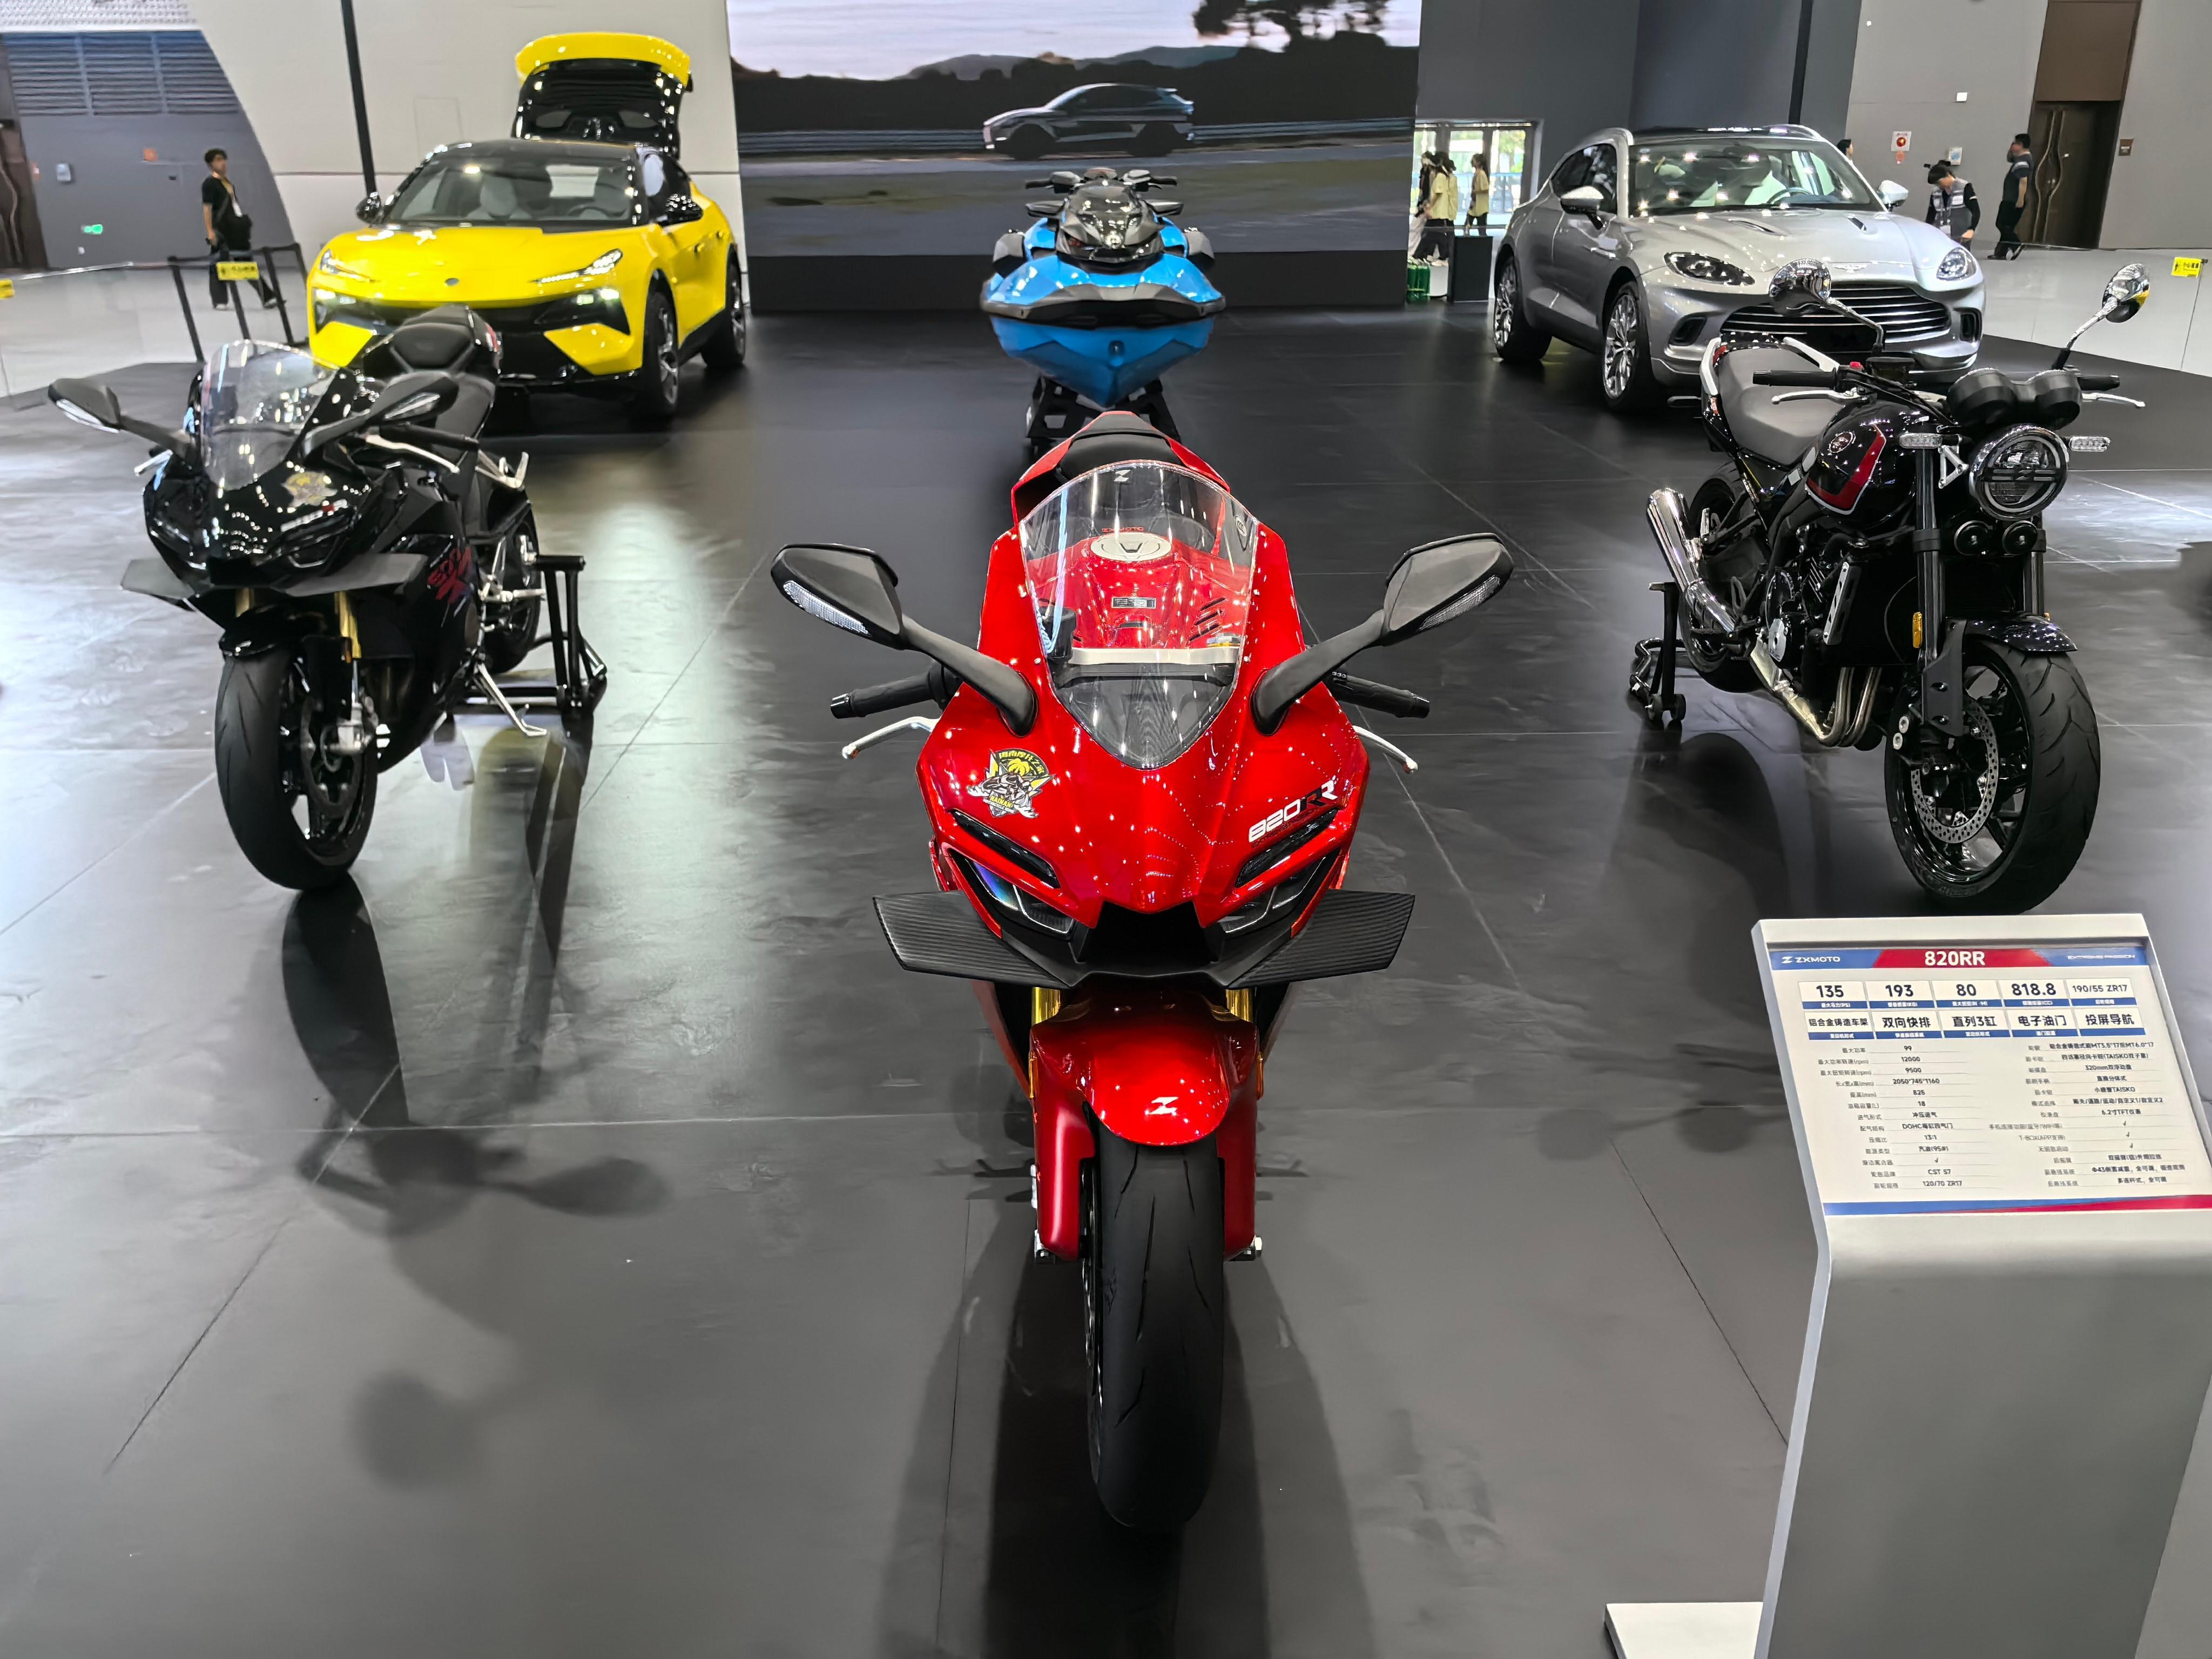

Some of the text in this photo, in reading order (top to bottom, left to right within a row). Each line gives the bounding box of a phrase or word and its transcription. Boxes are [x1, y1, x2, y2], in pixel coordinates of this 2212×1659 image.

[990, 795, 1013, 808] HAINAN
[1248, 780, 1338, 843] 820RR
[1924, 950, 1986, 966] 820RR
[1816, 984, 1845, 998] 135
[1885, 984, 1914, 997] 193
[1956, 983, 1977, 996] 80
[2011, 983, 2057, 996] 818.8
[2072, 984, 2128, 993] 190/55 ZR17
[1808, 1017, 1869, 1027] 铝合金铸造车架
[1881, 1016, 1931, 1028] 双向快排
[1951, 1015, 1998, 1027] 直列3缸
[2018, 1015, 2067, 1027] 电子油门
[2085, 1014, 2135, 1026] 投屏导航
